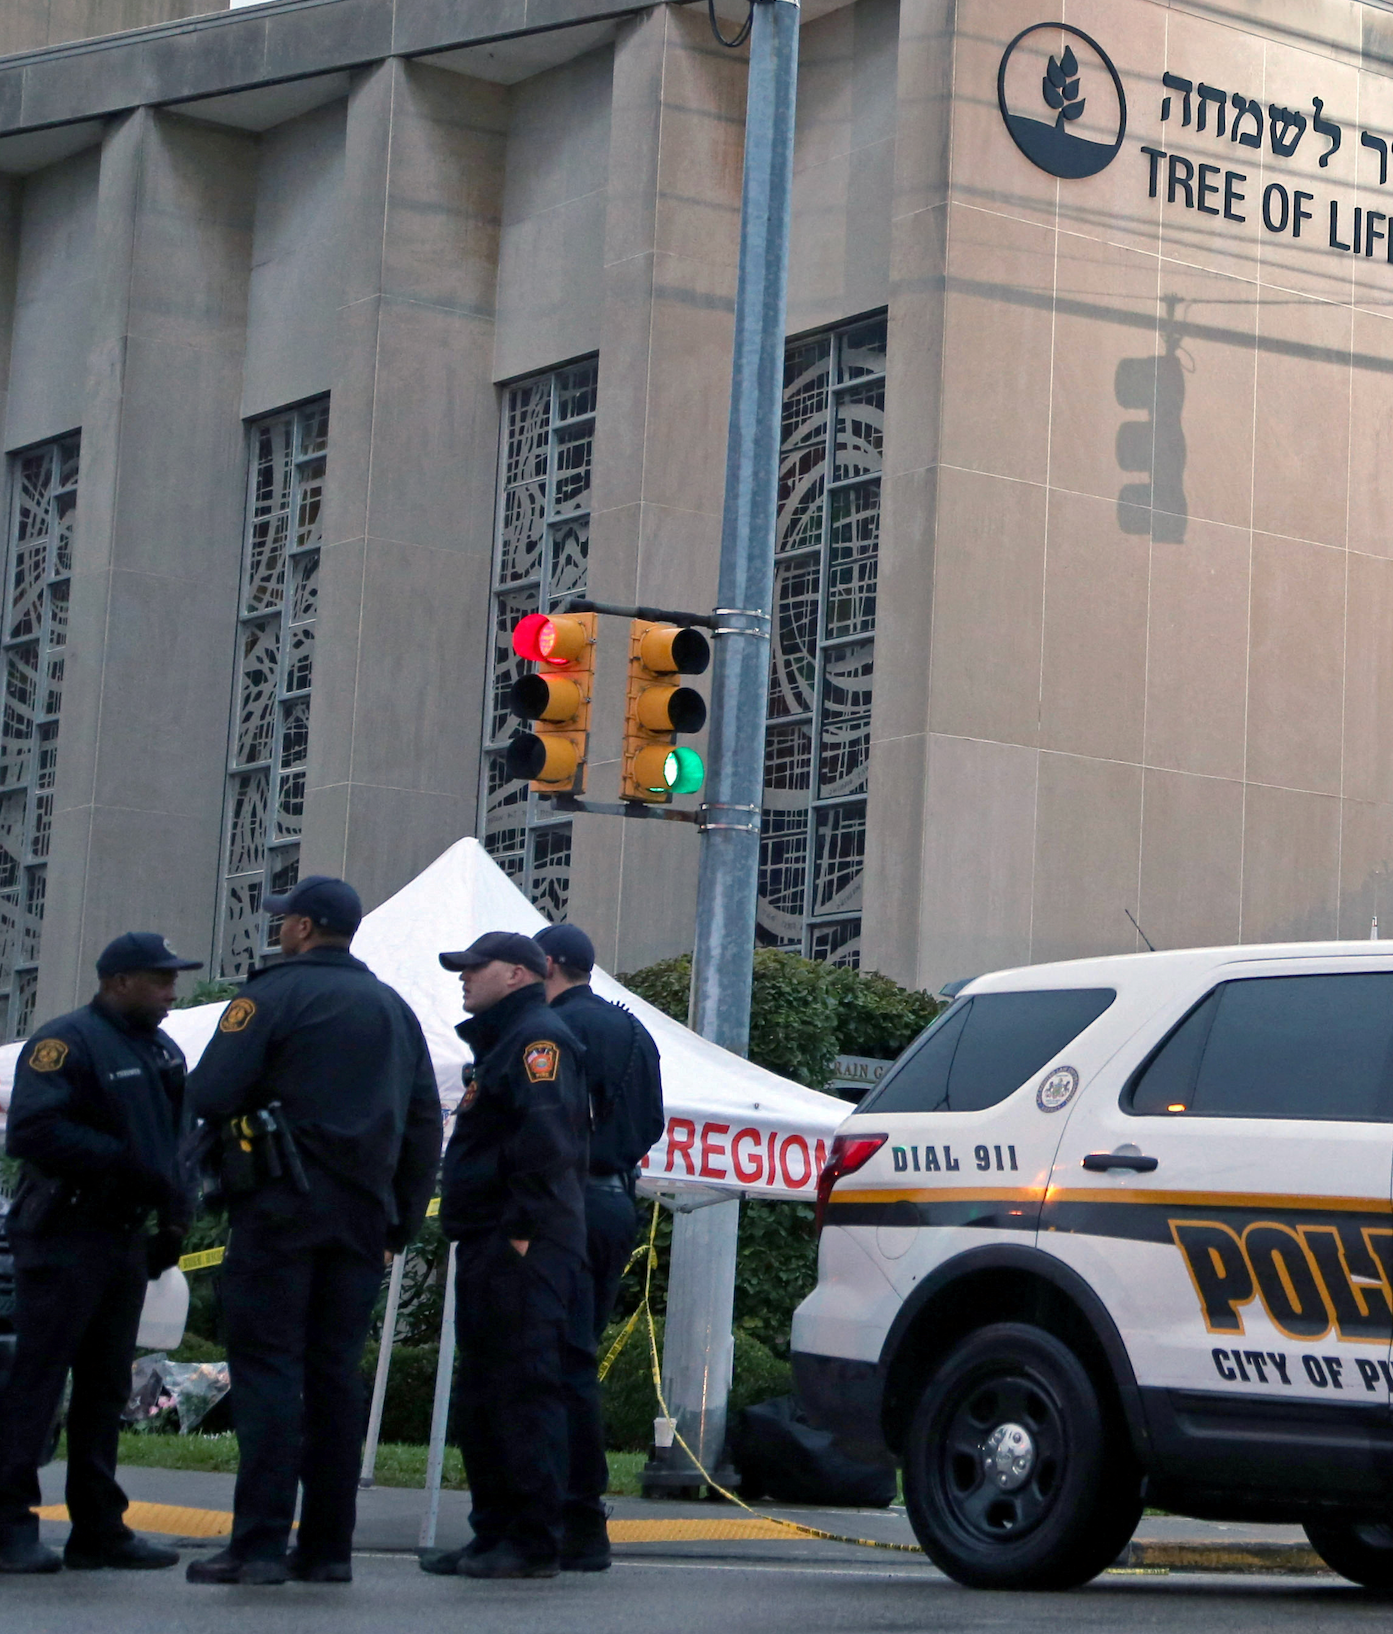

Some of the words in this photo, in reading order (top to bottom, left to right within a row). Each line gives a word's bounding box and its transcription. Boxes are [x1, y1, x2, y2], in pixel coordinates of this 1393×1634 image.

[1160, 71, 1342, 168] לשמחה
[1140, 146, 1247, 223] TREE
[1263, 184, 1313, 237] OF
[891, 1145, 960, 1172] DIAL
[974, 1144, 1019, 1172] 911
[1211, 1348, 1292, 1385] CITY
[1302, 1354, 1343, 1389] OF
